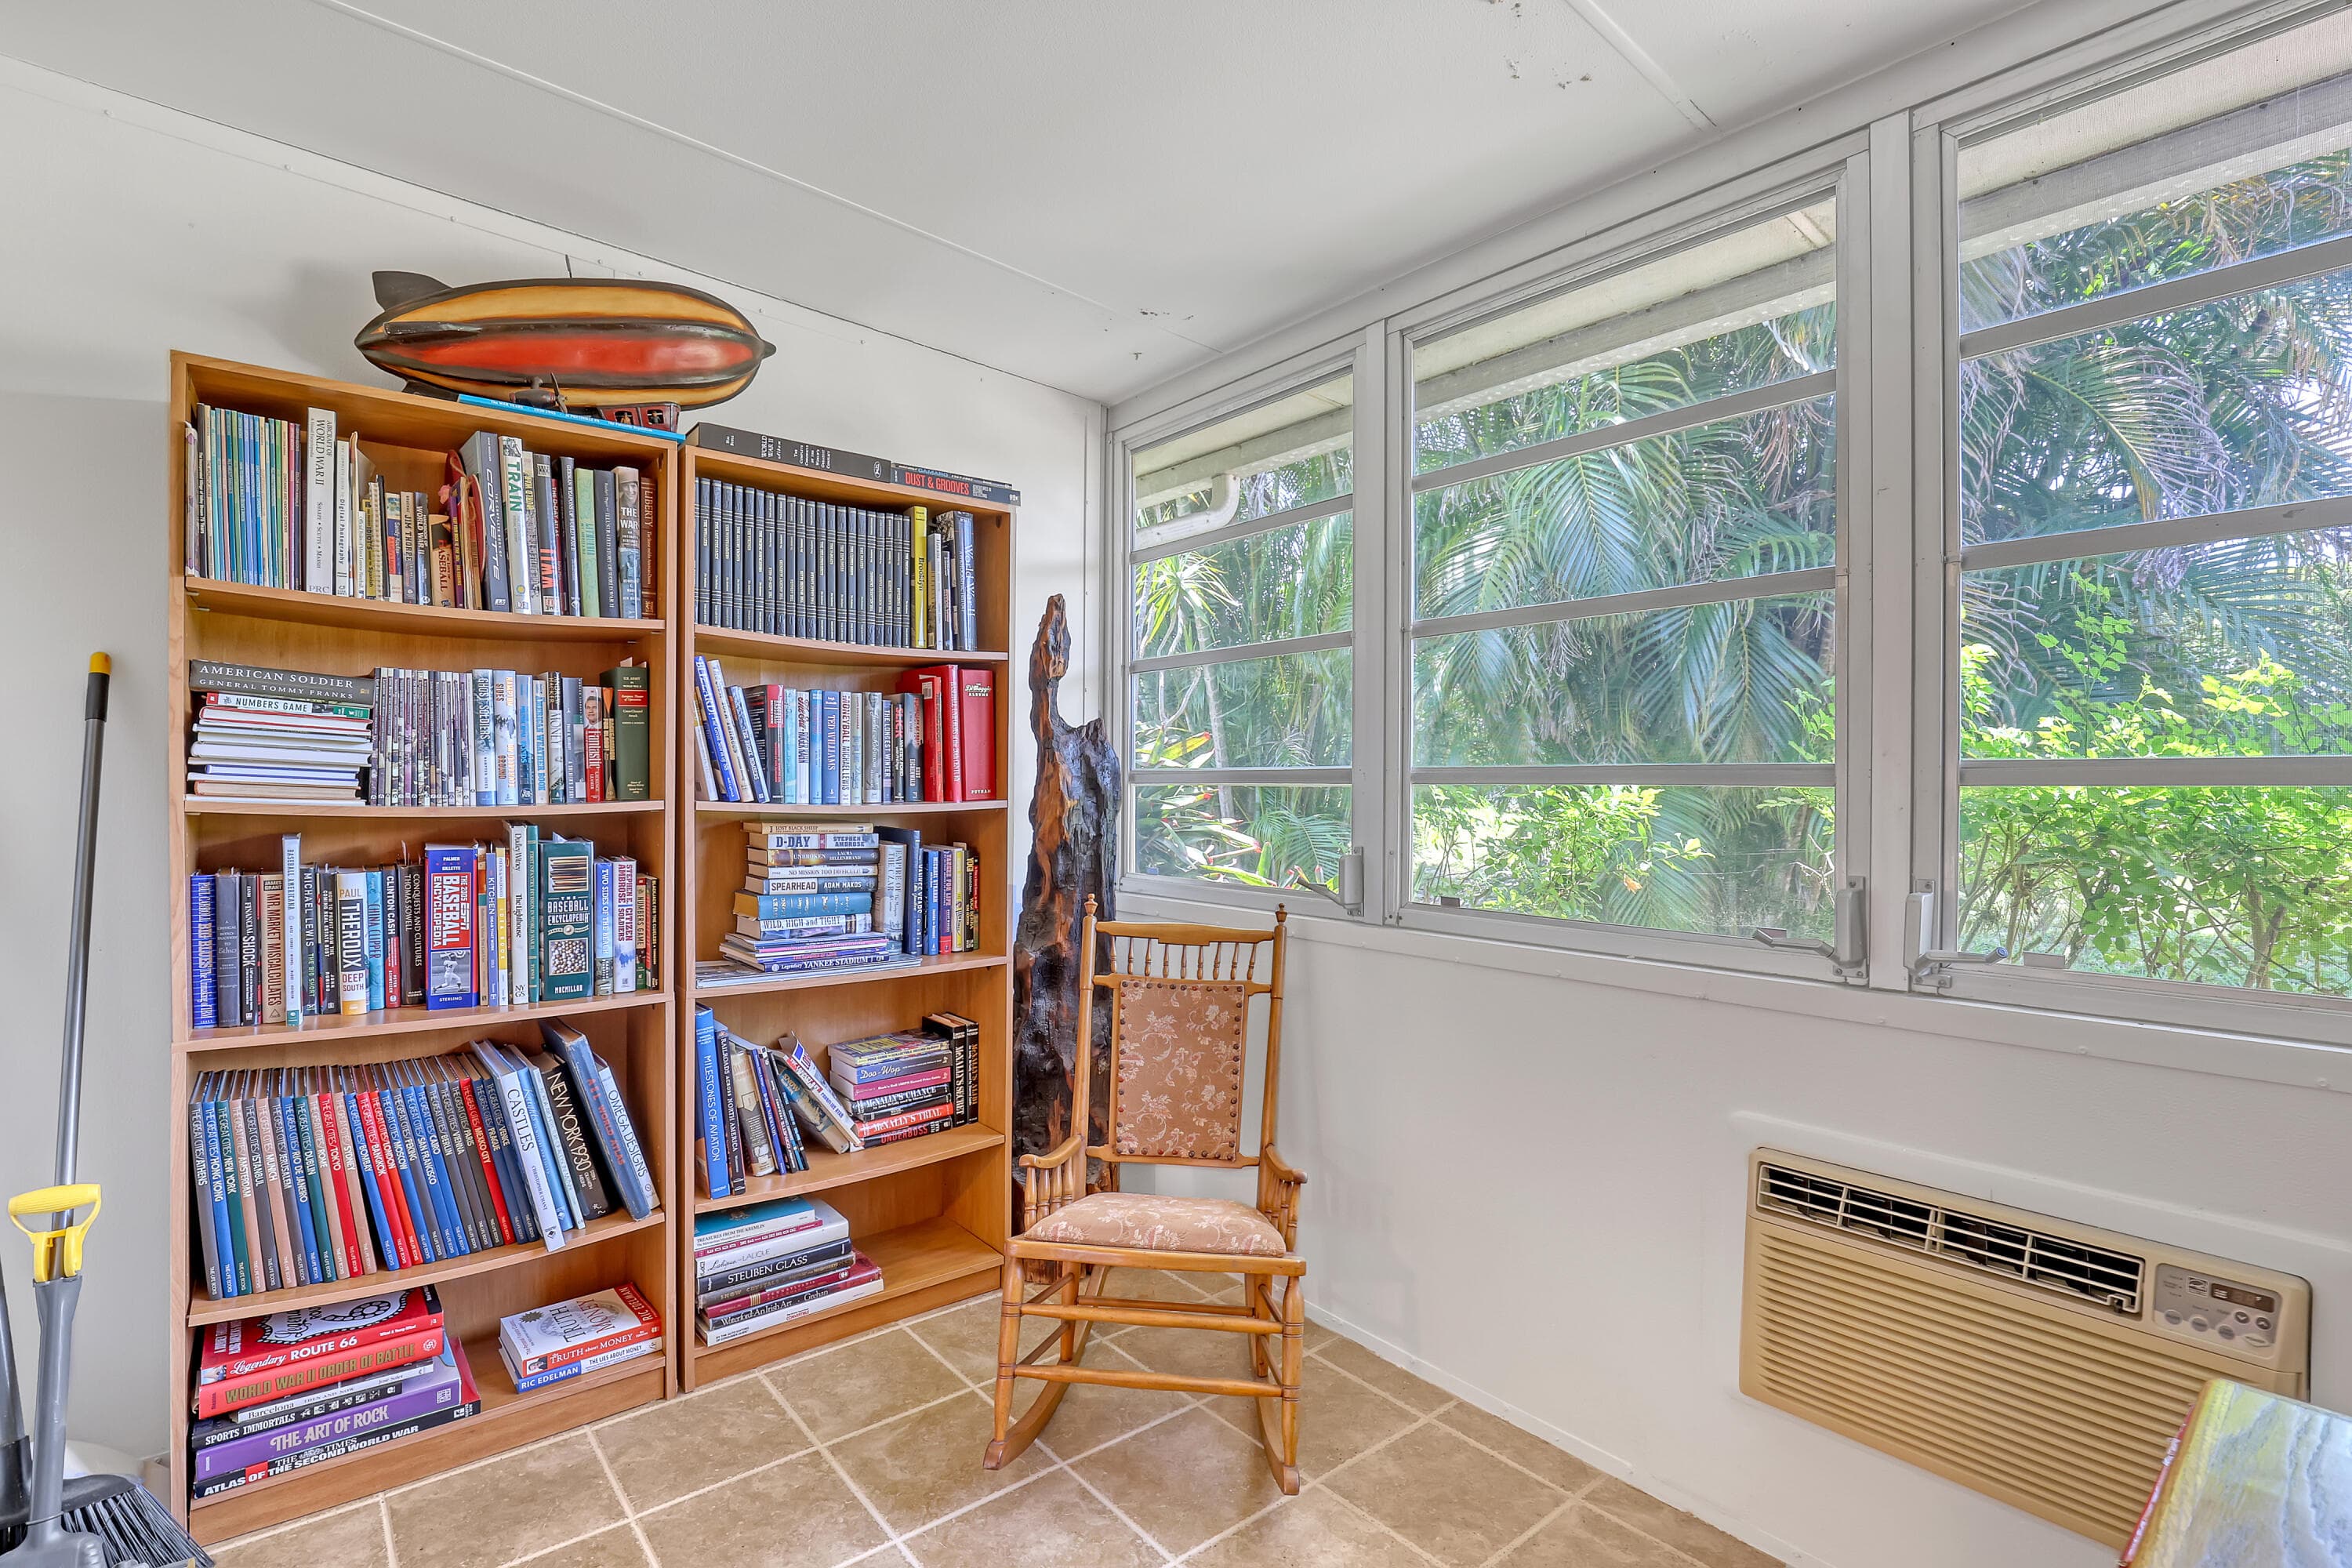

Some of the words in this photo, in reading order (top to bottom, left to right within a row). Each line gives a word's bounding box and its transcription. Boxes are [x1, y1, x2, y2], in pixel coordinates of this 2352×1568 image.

[316, 419, 325, 454] WORLD
[315, 477, 324, 485] II
[507, 462, 523, 513] TRAIN
[905, 472, 925, 486] DUST
[927, 477, 935, 489] &
[936, 478, 969, 495] GROOVES
[621, 506, 638, 517] THE
[644, 489, 653, 528] LIBERTY
[486, 469, 500, 579] CORVETTE
[620, 519, 639, 529] WAR
[405, 532, 413, 562] THORPE
[199, 665, 284, 681] AMERICAN
[289, 674, 354, 688] SOLDIER
[199, 679, 256, 690] GENERAL
[261, 684, 304, 695] TOMMY
[309, 689, 353, 699] FRANKS
[478, 677, 488, 701] GHOST
[235, 697, 278, 710] NUMBERS
[283, 702, 307, 713] GAME
[841, 695, 850, 743] MONEYBALL
[479, 702, 491, 740] SOLDIERS
[549, 713, 561, 745] MONEY
[827, 714, 836, 729] TED
[895, 707, 904, 738] SLICK
[588, 730, 602, 769] Fantastic
[827, 732, 836, 771] WILLIAMS
[775, 836, 811, 848] D-DAY
[267, 893, 281, 909] MR.
[303, 873, 314, 913] MICHAEL
[339, 888, 361, 898] PAUL
[771, 881, 816, 891] SPEARHEAD
[244, 902, 255, 935] FINANCIAL
[368, 904, 381, 927] CHINA
[434, 876, 443, 947] ENCYCLOPEDIA
[442, 875, 460, 946] BASEBALL
[547, 900, 589, 913] BASEBALL
[547, 913, 589, 926] ENCYCLOPEDIA
[267, 910, 281, 940] MARKET
[304, 915, 314, 947] LEWIS
[341, 902, 362, 968] THEROUX
[387, 912, 395, 935] CASH
[763, 920, 783, 929] WILD,
[786, 918, 803, 927] HIGH
[805, 917, 818, 926] and
[820, 916, 840, 925] TIGHT
[243, 935, 256, 967] SHOCK
[369, 928, 381, 959] CLIPPER
[267, 941, 282, 1006] MISCALCULATES
[803, 959, 833, 969] YANKEE
[834, 956, 868, 965] STADIUM
[342, 973, 364, 983] DEEP
[704, 1054, 716, 1108] MILESTONES
[859, 1065, 901, 1080] Doo-Wop
[547, 1072, 572, 1109] NEW
[720, 1036, 729, 1075] RAILROADS
[729, 1120, 739, 1152] AMERICA
[906, 1085, 937, 1098] CHANCE
[191, 1108, 201, 1120] THE
[192, 1120, 203, 1138] GREAT
[507, 1088, 535, 1152] CASTLES
[560, 1107, 584, 1148] YORK
[708, 1109, 717, 1121] OF
[916, 1108, 942, 1121] TRIAL
[598, 1104, 615, 1135] WORLD
[610, 1139, 626, 1166] ATLAS
[608, 1089, 630, 1132] OMEGA
[622, 1132, 648, 1178] DESIGNS
[709, 1123, 720, 1162] AVIATION
[880, 1126, 928, 1144] UNDERBOSS
[421, 1148, 437, 1185] FRANCISCO
[571, 1142, 592, 1172] 1930
[212, 1181, 223, 1202] KONG
[227, 1173, 237, 1195] YORK
[728, 1265, 773, 1284] STEUBEN
[775, 1254, 808, 1272] GLASS
[804, 1289, 829, 1302] Grehan
[549, 1305, 586, 1344] TRUTH
[576, 1298, 615, 1334] MONEY
[230, 1354, 287, 1374] Legendary
[290, 1342, 335, 1360] ROUTE
[339, 1336, 358, 1348] 66
[549, 1348, 584, 1364] TRUTH
[600, 1334, 633, 1349] MONEY
[599, 1355, 609, 1363] LIES
[609, 1351, 625, 1361] ABOUT
[625, 1345, 643, 1357] MONEY
[225, 1380, 272, 1404] WORLD
[275, 1374, 304, 1391] WAR
[307, 1370, 315, 1382] II
[318, 1358, 358, 1378] ORDER
[360, 1354, 374, 1367] OF
[376, 1342, 415, 1363] BATTLE
[521, 1379, 535, 1389] RIC
[537, 1367, 579, 1385] EDELMAN
[248, 1403, 295, 1419] Barcelona
[205, 1427, 240, 1446] SPORTS
[242, 1412, 296, 1434] IMMORTALS
[270, 1431, 303, 1453] THE
[303, 1421, 332, 1443] ART
[334, 1414, 351, 1434] OF
[353, 1404, 390, 1429] ROCK
[204, 1475, 247, 1496] ATLAS
[248, 1471, 267, 1483] OF
[267, 1463, 292, 1477] THE
[294, 1448, 346, 1469] SECOND
[347, 1434, 390, 1454] WORLD
[391, 1425, 419, 1442] WAR
[274, 1454, 298, 1466] THE
[324, 1437, 358, 1451] TIMES
